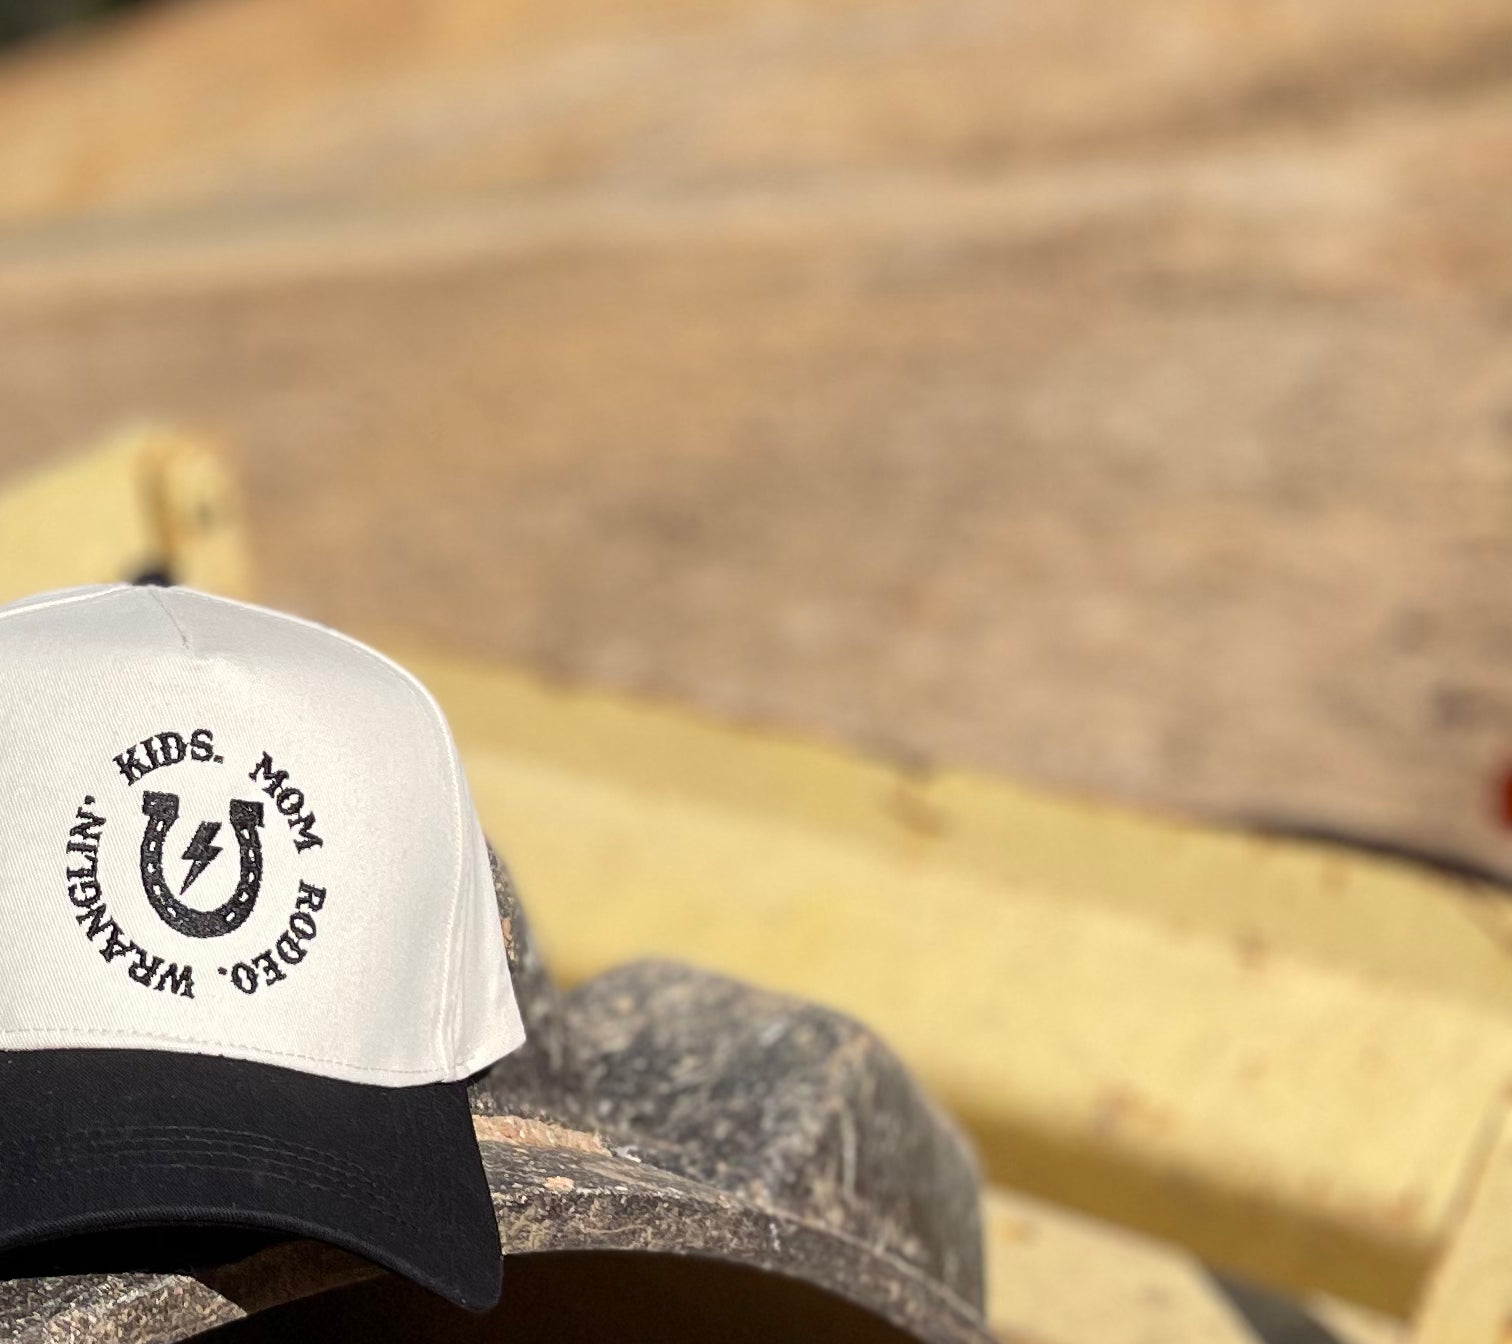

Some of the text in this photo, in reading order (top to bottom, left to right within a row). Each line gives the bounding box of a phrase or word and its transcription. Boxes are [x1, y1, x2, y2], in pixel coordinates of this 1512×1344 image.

[112, 728, 224, 787] KIDS.
[249, 750, 324, 854] MOM
[217, 878, 327, 995] RODEO.
